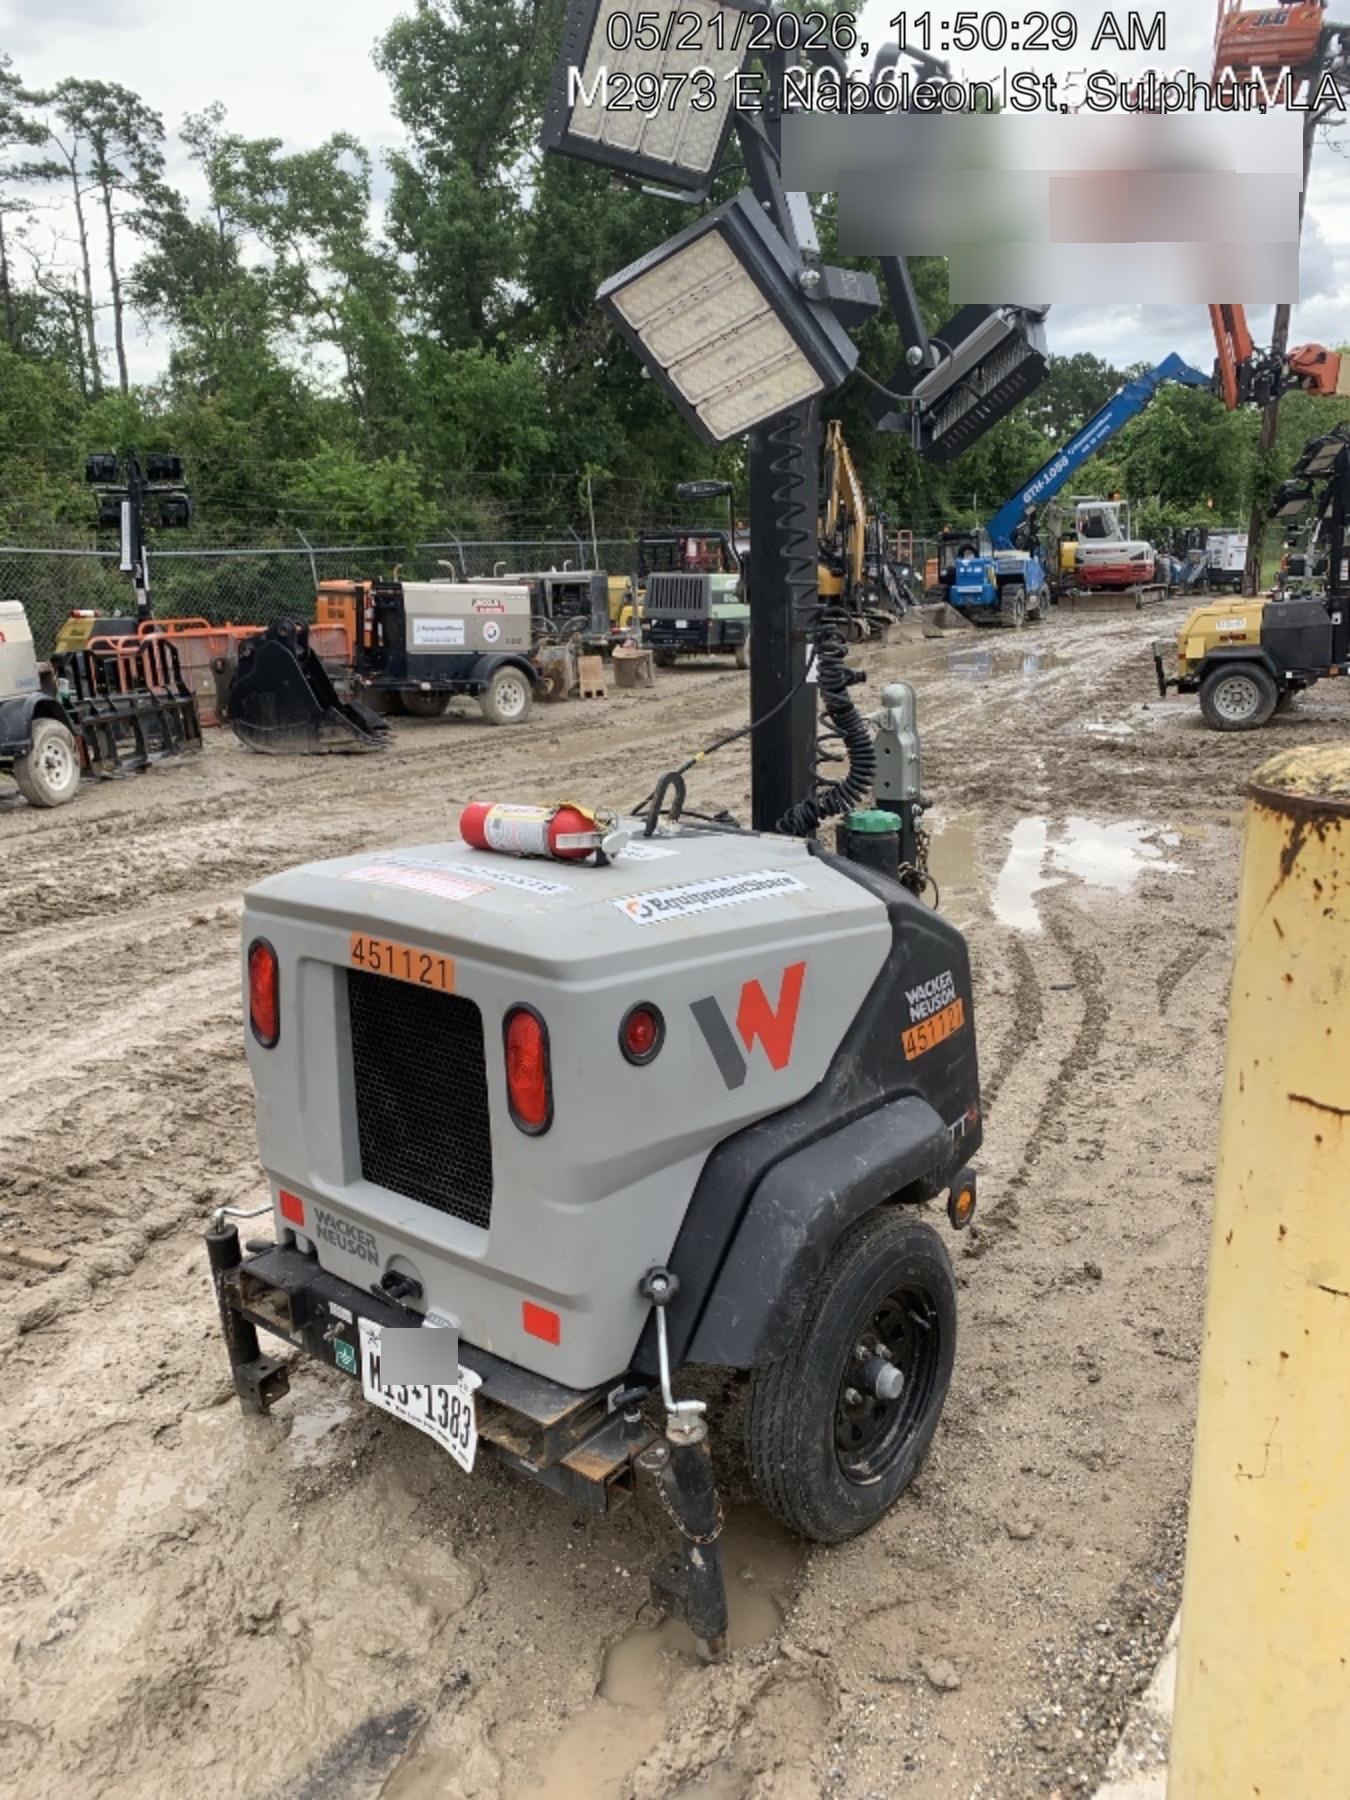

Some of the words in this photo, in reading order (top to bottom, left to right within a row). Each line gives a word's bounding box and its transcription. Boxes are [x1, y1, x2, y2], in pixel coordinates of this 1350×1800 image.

[352, 937, 446, 988] 451121
[905, 970, 953, 1002] WACKER
[909, 985, 956, 1023] NEUSON
[907, 1003, 962, 1053] 451121
[314, 1207, 377, 1250] WACKER
[316, 1223, 379, 1267] NEUSON
